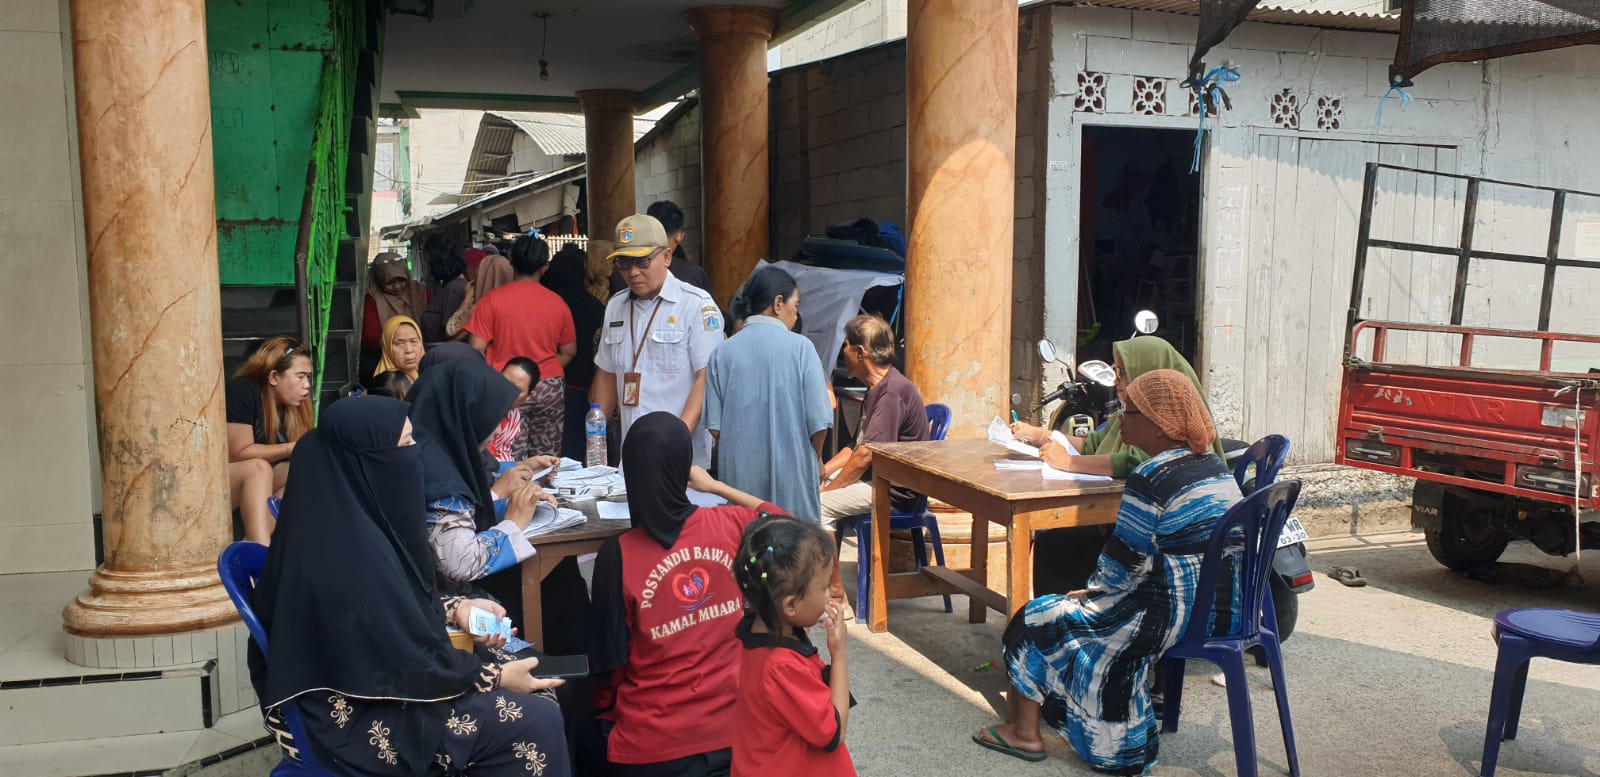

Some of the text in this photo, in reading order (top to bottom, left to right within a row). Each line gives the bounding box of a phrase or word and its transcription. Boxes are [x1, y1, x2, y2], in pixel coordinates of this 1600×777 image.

[1421, 391, 1505, 422] VIAR
[1414, 505, 1438, 516] VIAR
[640, 548, 691, 609] POSYANDU
[650, 597, 741, 640] KAMAL MUARA
